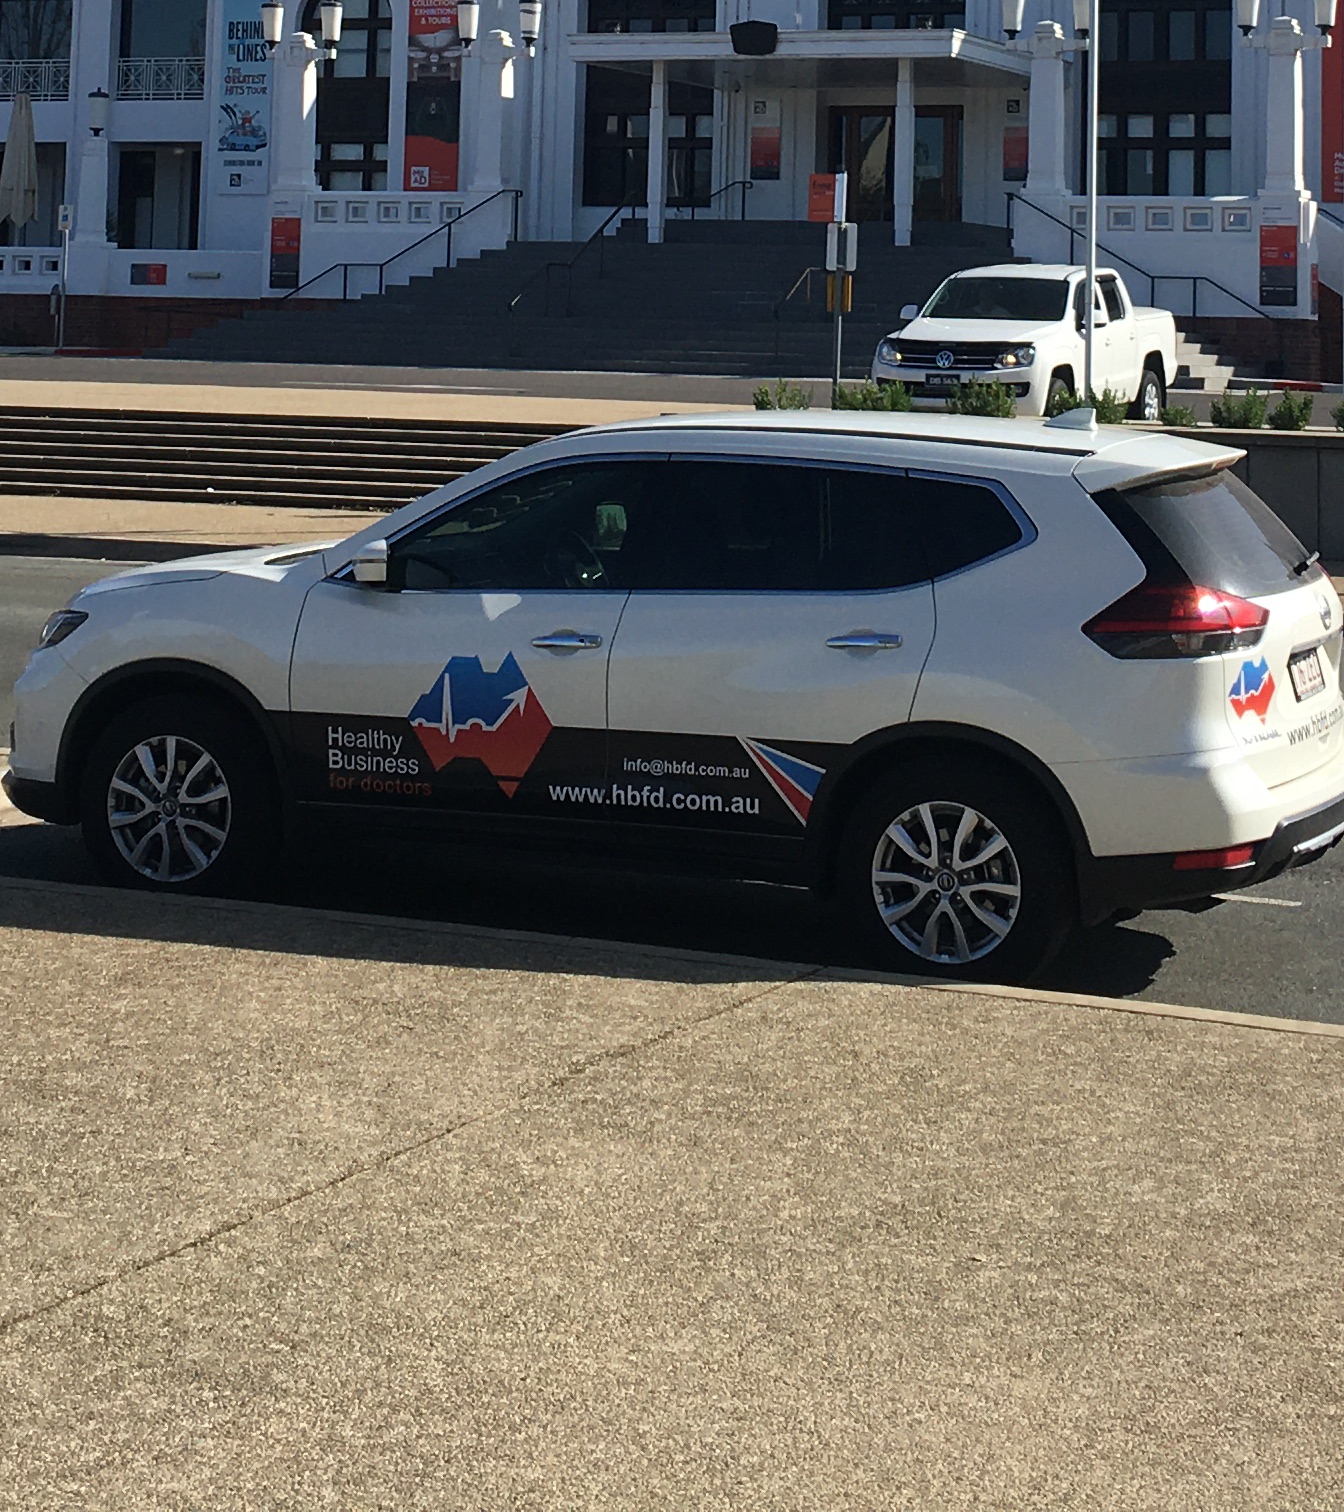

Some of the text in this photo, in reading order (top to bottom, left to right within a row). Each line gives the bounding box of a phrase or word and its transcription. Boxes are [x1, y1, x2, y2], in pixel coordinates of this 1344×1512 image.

[428, 16, 451, 25] TOURS
[236, 42, 267, 63] LINES
[327, 725, 404, 756] Healthy
[327, 748, 420, 775] Business
[623, 757, 750, 779] info@hbfd.com.au
[328, 773, 433, 796] for doctors
[548, 783, 760, 815] www.hbfd.com.au
